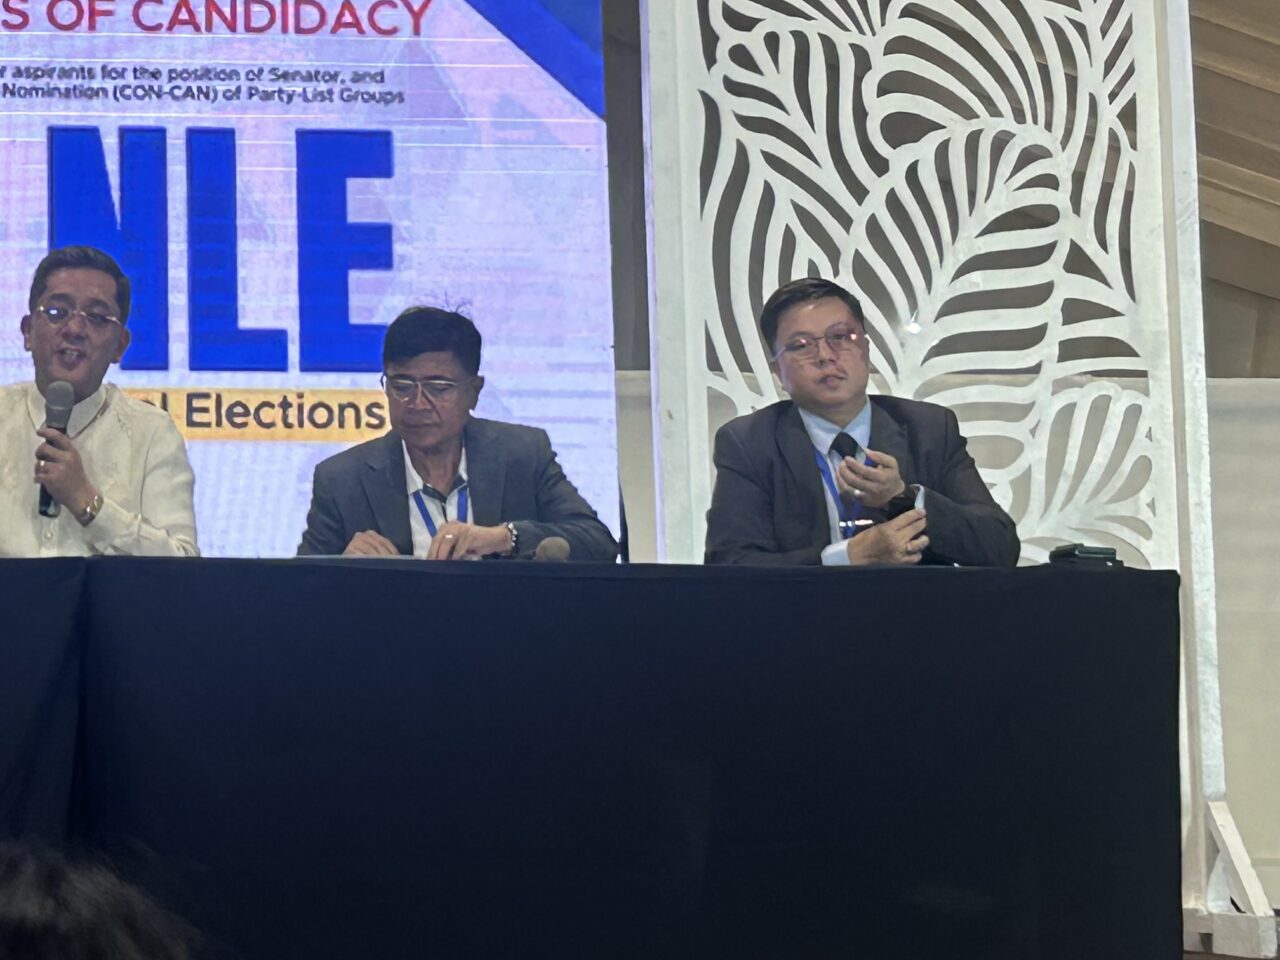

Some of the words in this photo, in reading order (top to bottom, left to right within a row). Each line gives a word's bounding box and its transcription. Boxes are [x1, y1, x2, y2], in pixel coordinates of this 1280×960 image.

[11, 64, 95, 81] aspirants
[101, 64, 128, 80] for
[133, 65, 162, 81] the
[168, 66, 241, 84] position
[245, 67, 264, 82] of
[268, 67, 346, 84] Senator,
[350, 69, 385, 84] and
[2, 83, 108, 100] Nomination
[113, 84, 218, 103] (CON-CAN)
[223, 85, 240, 101] of
[247, 86, 334, 104] Party-List
[340, 87, 405, 105] Groups
[46, 125, 394, 374] NLE
[186, 391, 387, 431] Elections
